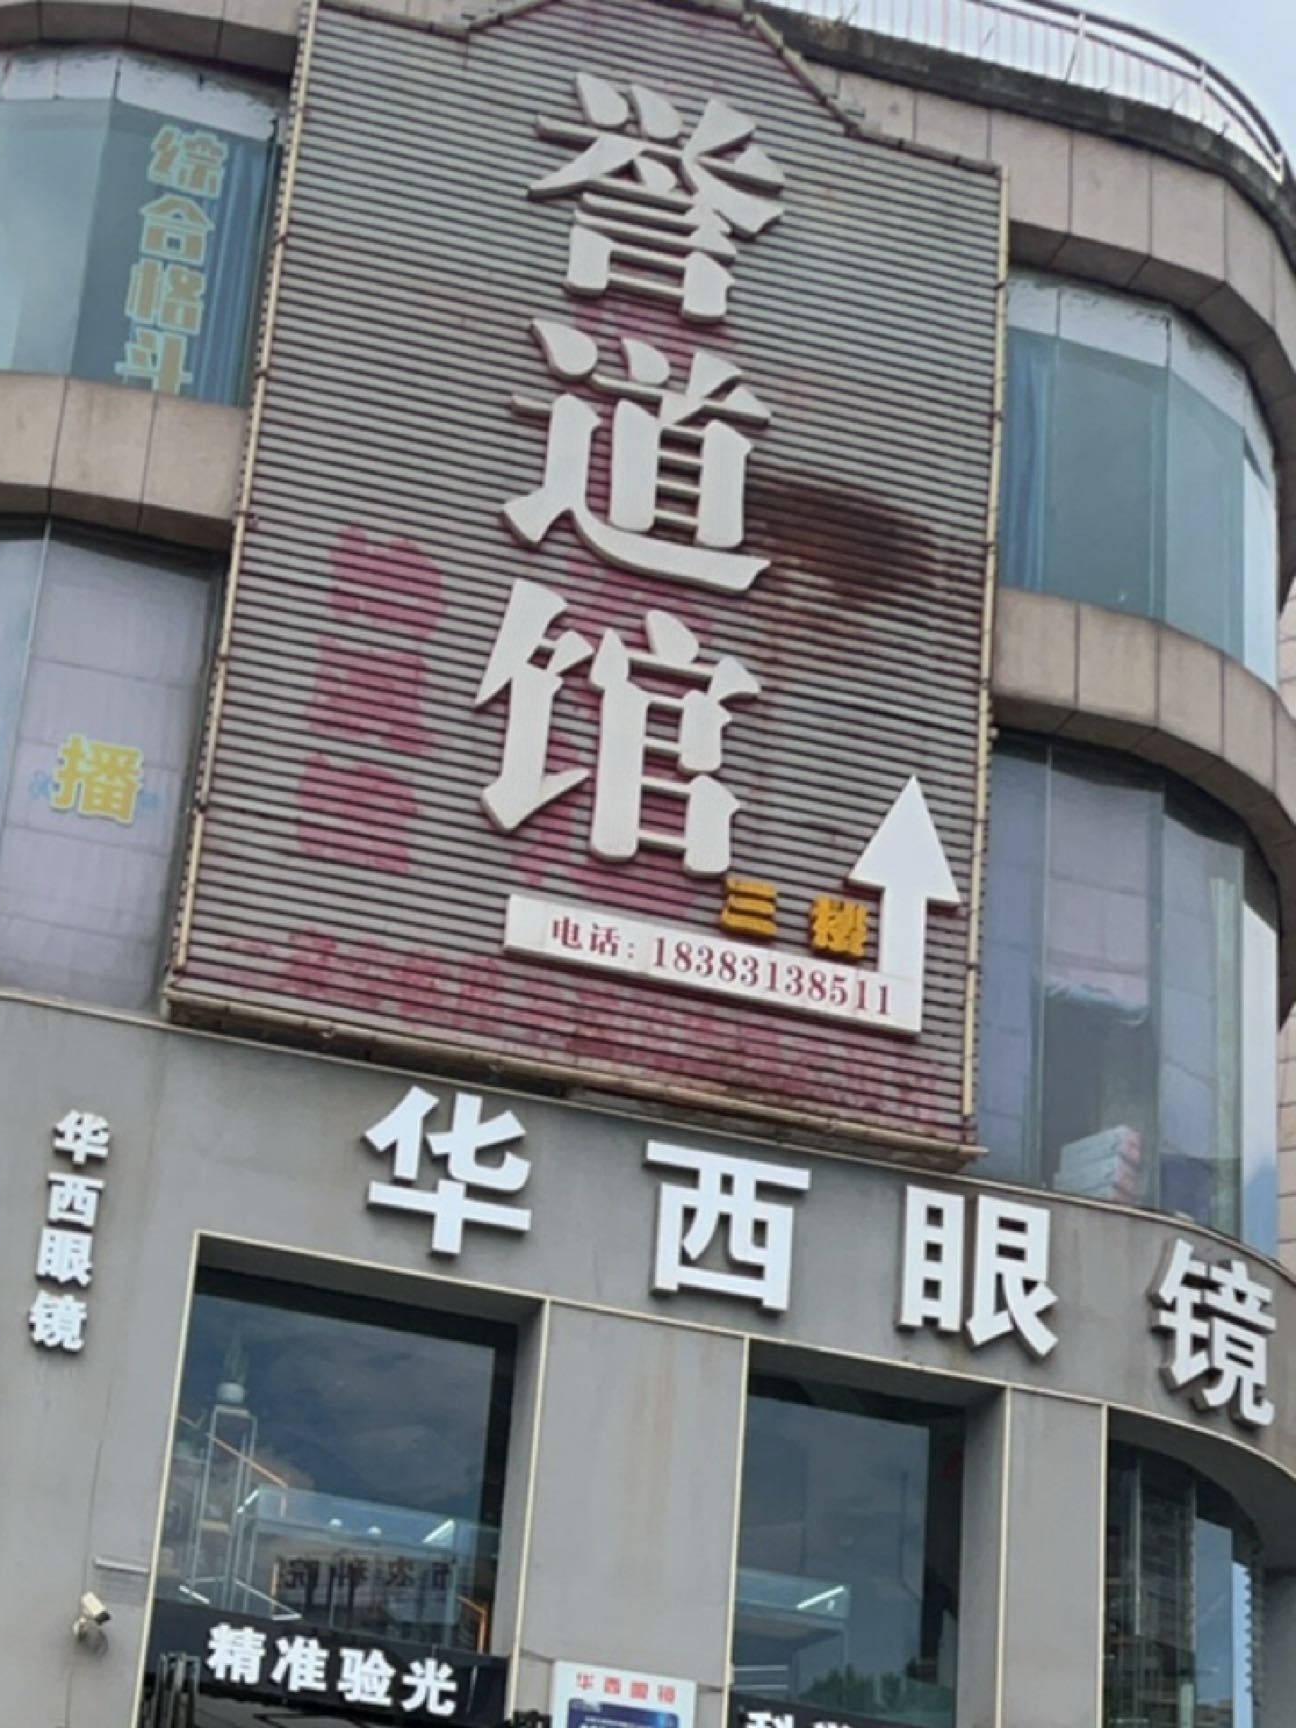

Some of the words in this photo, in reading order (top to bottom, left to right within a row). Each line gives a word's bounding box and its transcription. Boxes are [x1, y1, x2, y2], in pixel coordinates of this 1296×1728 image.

[114, 123, 229, 396] 综合格斗
[475, 71, 785, 877] 誉道馆
[719, 875, 870, 962] 三楼
[29, 1108, 112, 1355] 华西眼镜
[364, 1085, 1277, 1430] 华西眼镜
[206, 1621, 460, 1717] 精准验光
